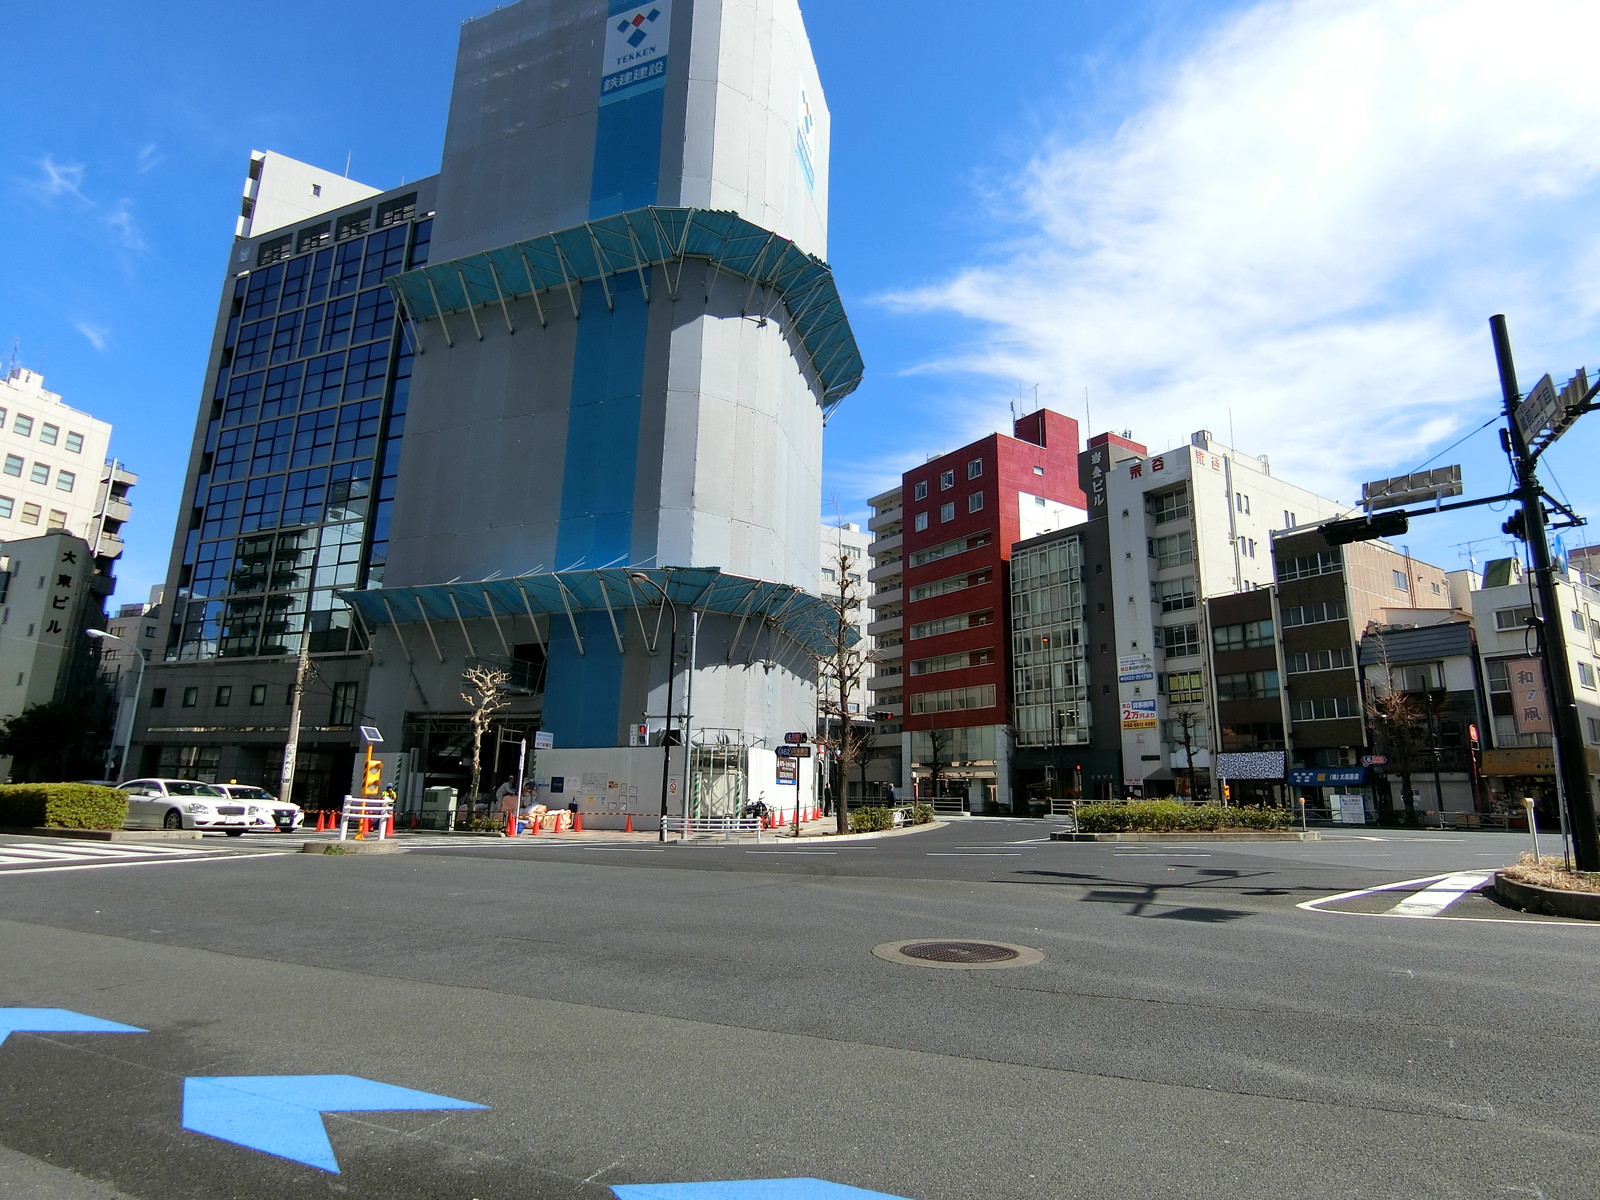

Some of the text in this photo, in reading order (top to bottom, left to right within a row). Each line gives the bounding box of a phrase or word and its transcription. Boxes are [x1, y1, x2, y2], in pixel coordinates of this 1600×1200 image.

[615, 45, 657, 66] TEKKEN
[603, 61, 664, 92] 鉄建建設
[46, 550, 78, 634] 大東ビル
